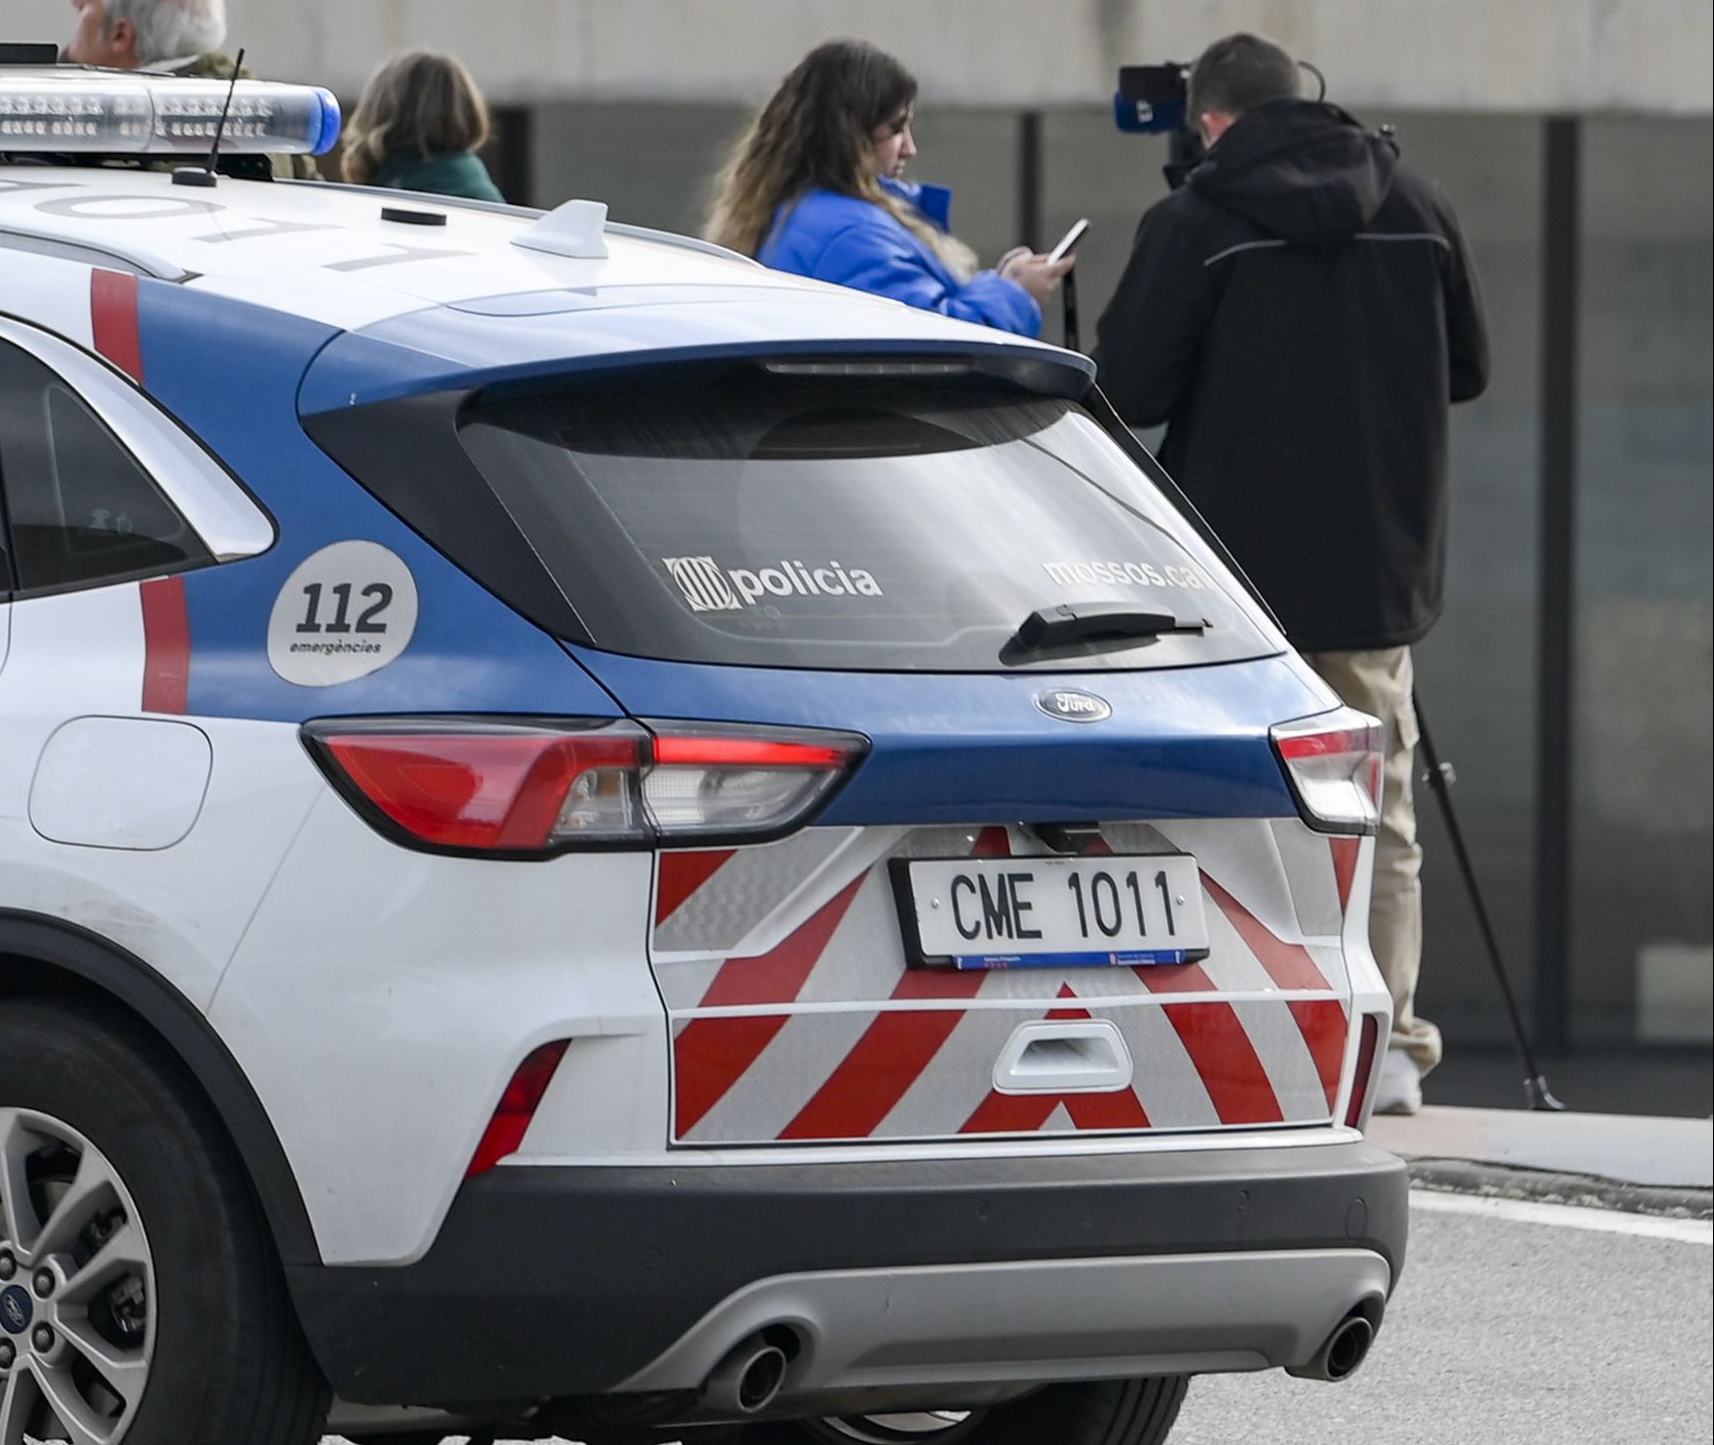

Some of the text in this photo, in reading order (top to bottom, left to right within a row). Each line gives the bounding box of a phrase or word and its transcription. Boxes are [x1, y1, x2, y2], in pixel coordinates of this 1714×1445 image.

[727, 560, 884, 606] policia
[295, 582, 394, 634] 112
[289, 639, 382, 656] emergències
[950, 870, 1176, 941] CME 1011
